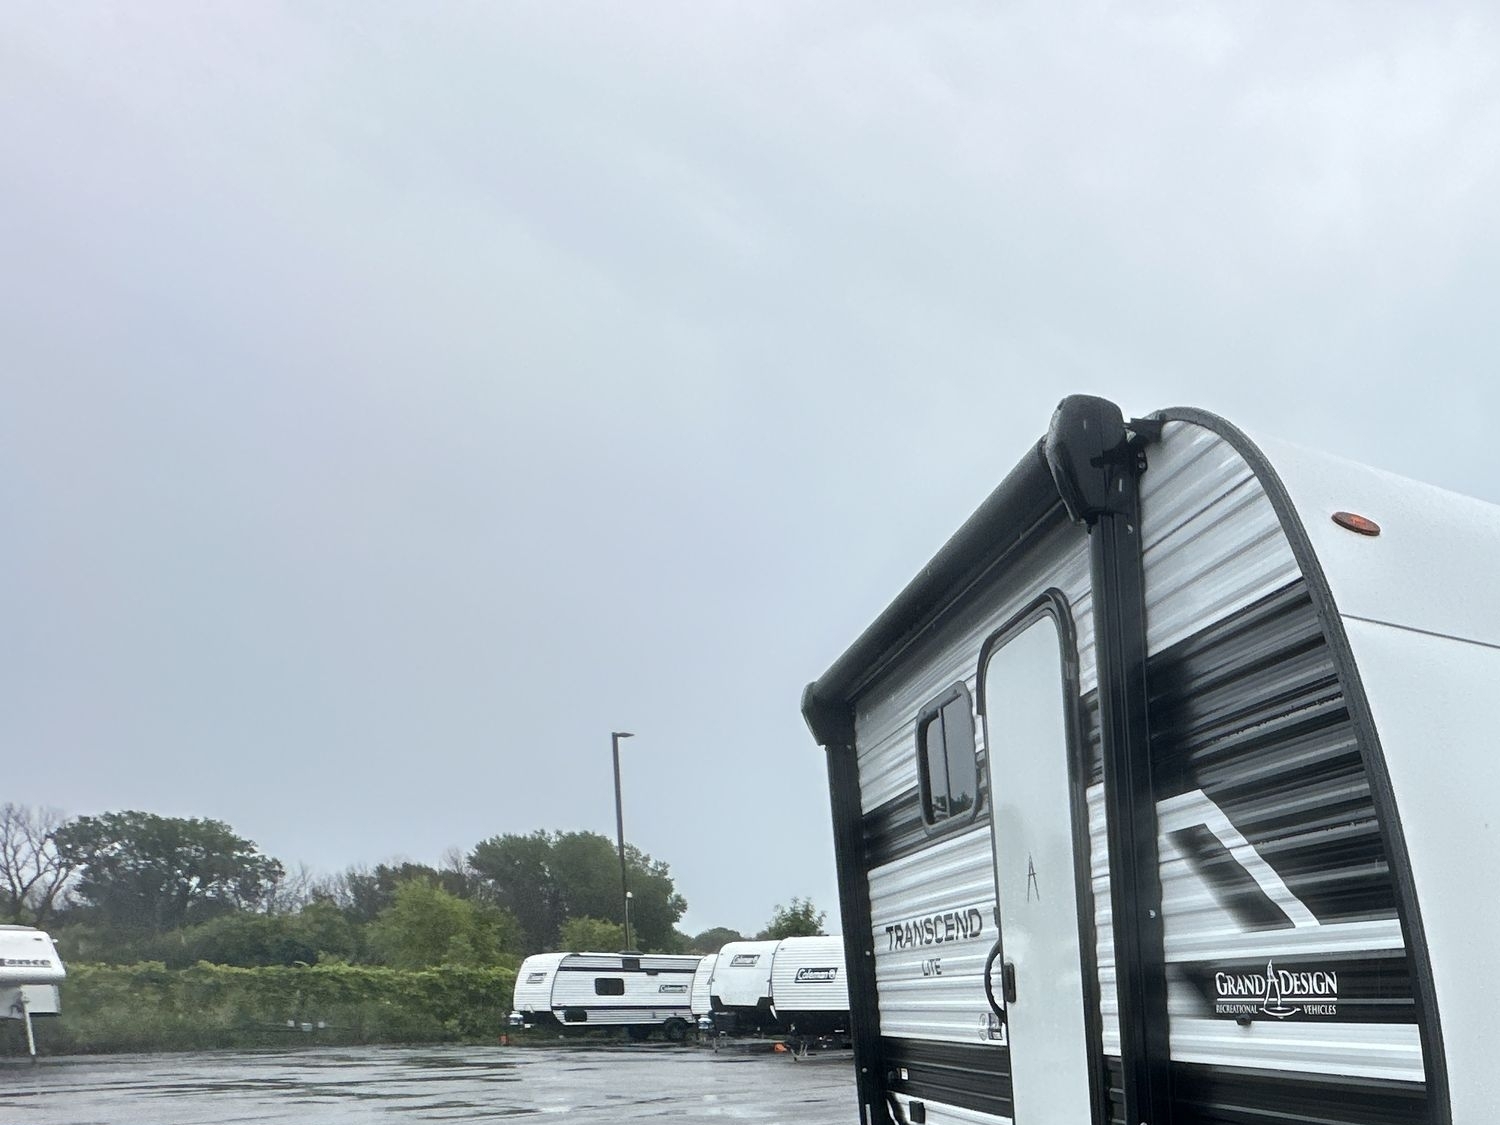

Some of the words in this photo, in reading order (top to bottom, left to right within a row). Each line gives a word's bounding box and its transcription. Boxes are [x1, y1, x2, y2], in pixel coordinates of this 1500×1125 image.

[885, 908, 983, 951] TRANSCEND
[921, 958, 942, 977] LITE
[1215, 972, 1265, 995] GRAND
[1277, 970, 1338, 995] DESIGN
[1215, 1004, 1258, 1015] RECREATIONAL
[1303, 1004, 1337, 1016] VEHICLES
